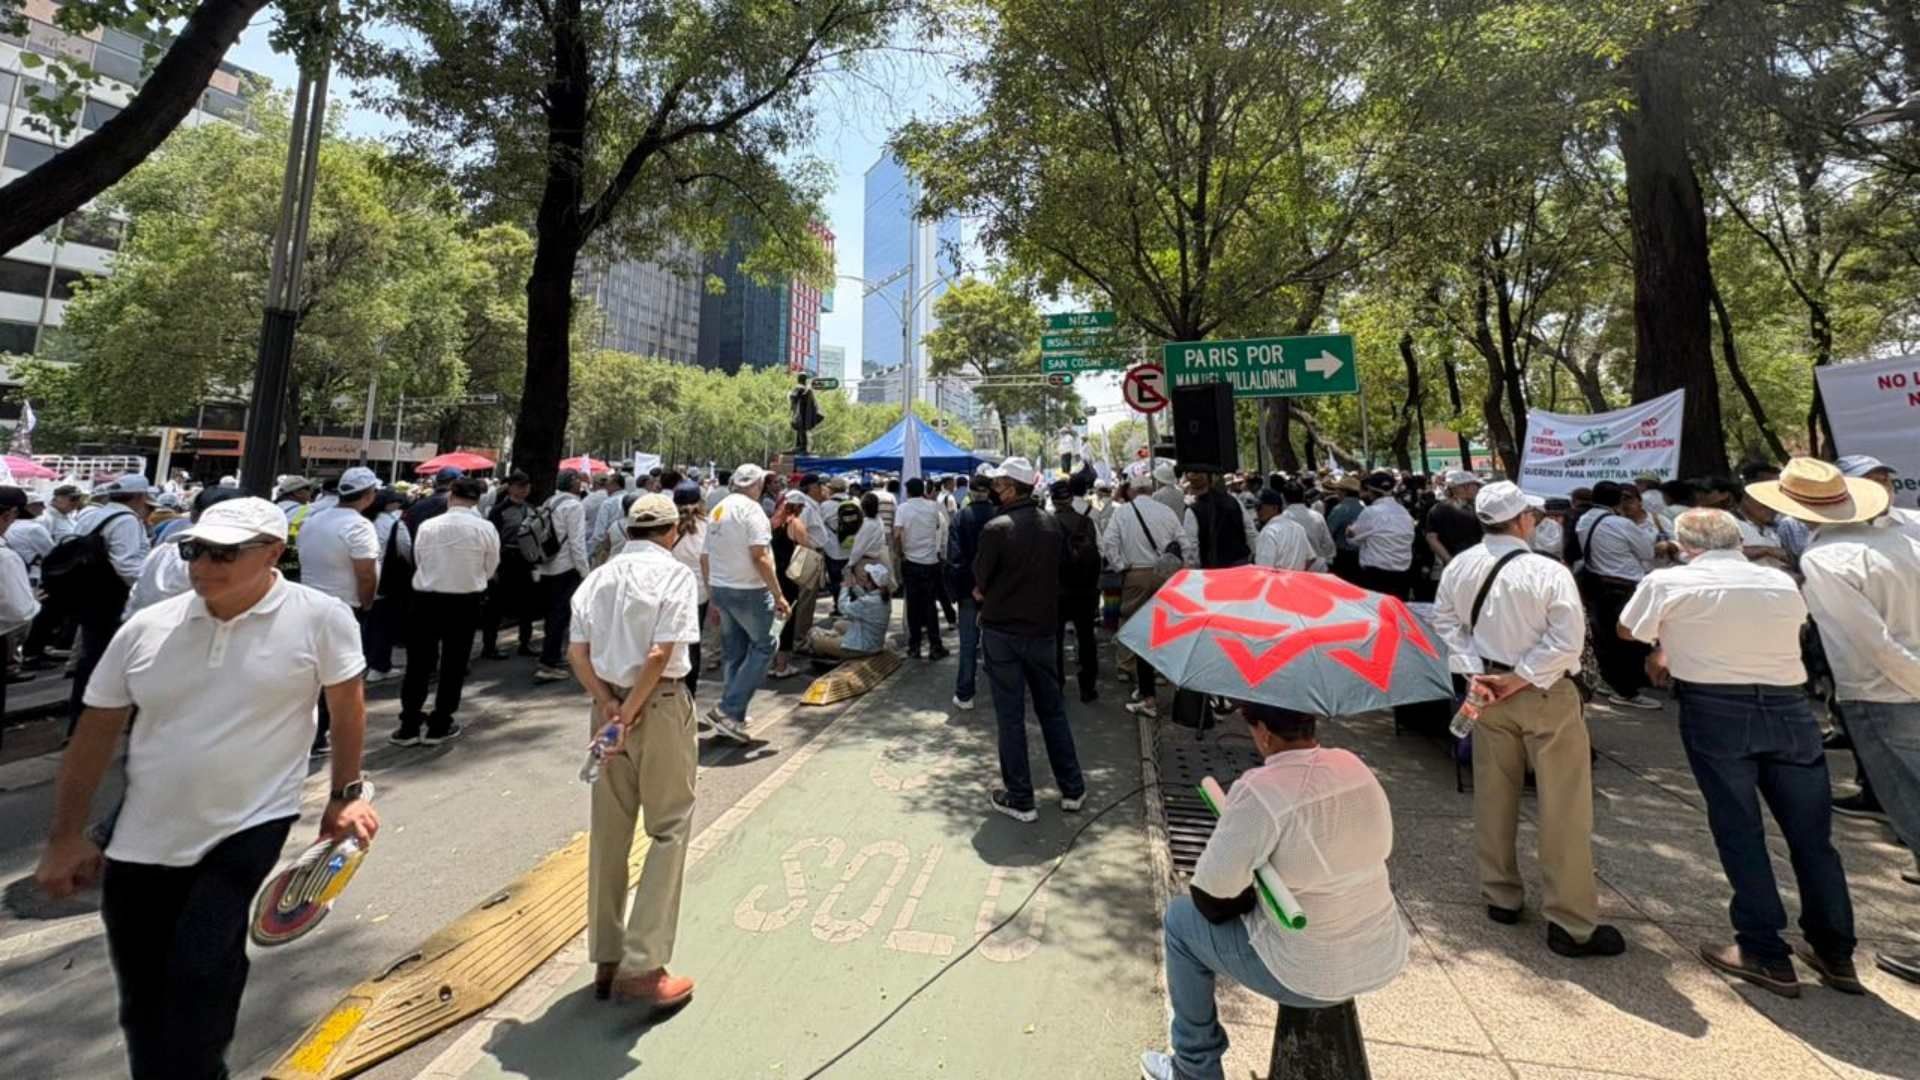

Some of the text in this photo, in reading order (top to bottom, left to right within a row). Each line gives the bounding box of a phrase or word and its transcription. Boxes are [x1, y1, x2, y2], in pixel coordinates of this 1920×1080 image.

[1069, 315, 1098, 326] NIZA
[1184, 344, 1284, 368] PARIS POR
[1047, 359, 1068, 370] SAN
[1226, 368, 1297, 390] VILLALONGIN
[1877, 373, 1906, 389] NO
[1565, 469, 1585, 478] PARA
[1586, 468, 1628, 479] NUESTRA
